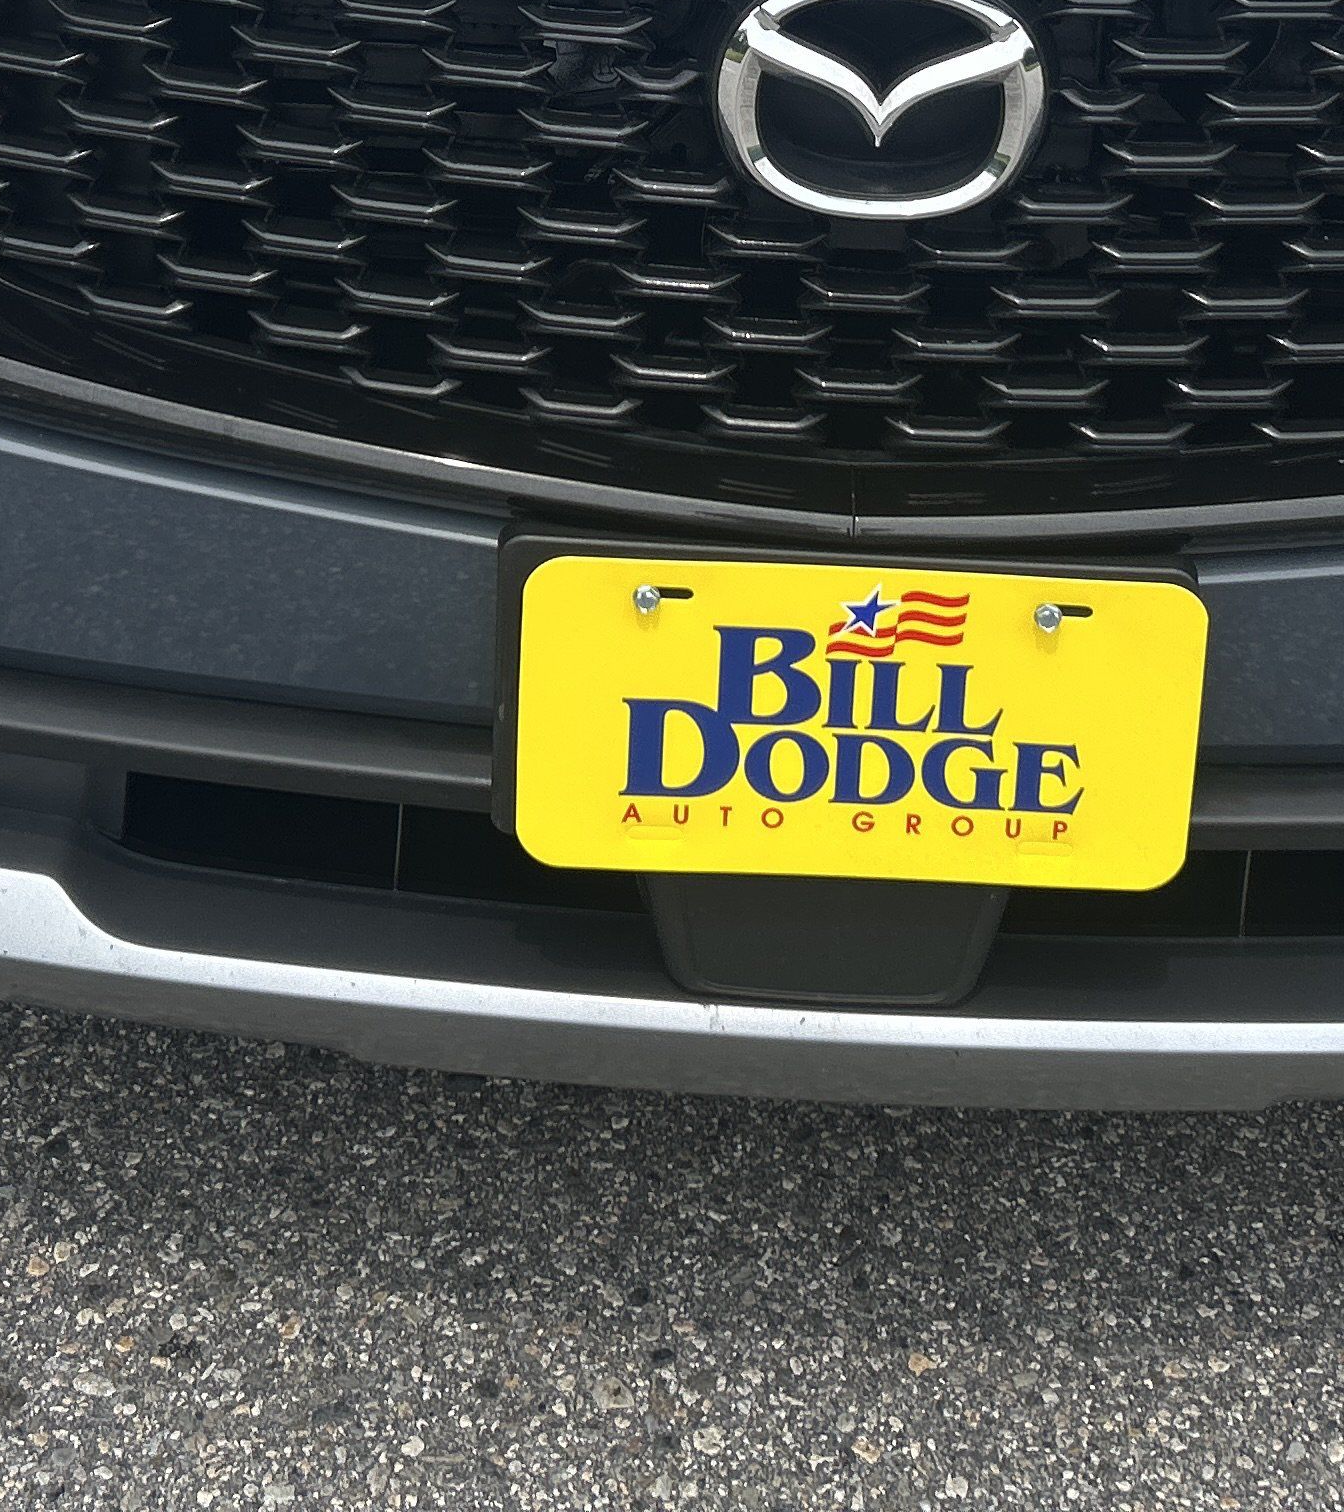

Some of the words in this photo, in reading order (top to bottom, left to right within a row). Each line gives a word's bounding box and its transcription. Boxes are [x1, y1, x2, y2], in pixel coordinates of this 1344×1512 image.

[712, 624, 1003, 734] BILL
[618, 697, 1085, 815] DODGE
[621, 802, 784, 829] AUTO
[851, 810, 1069, 840] GROUP
